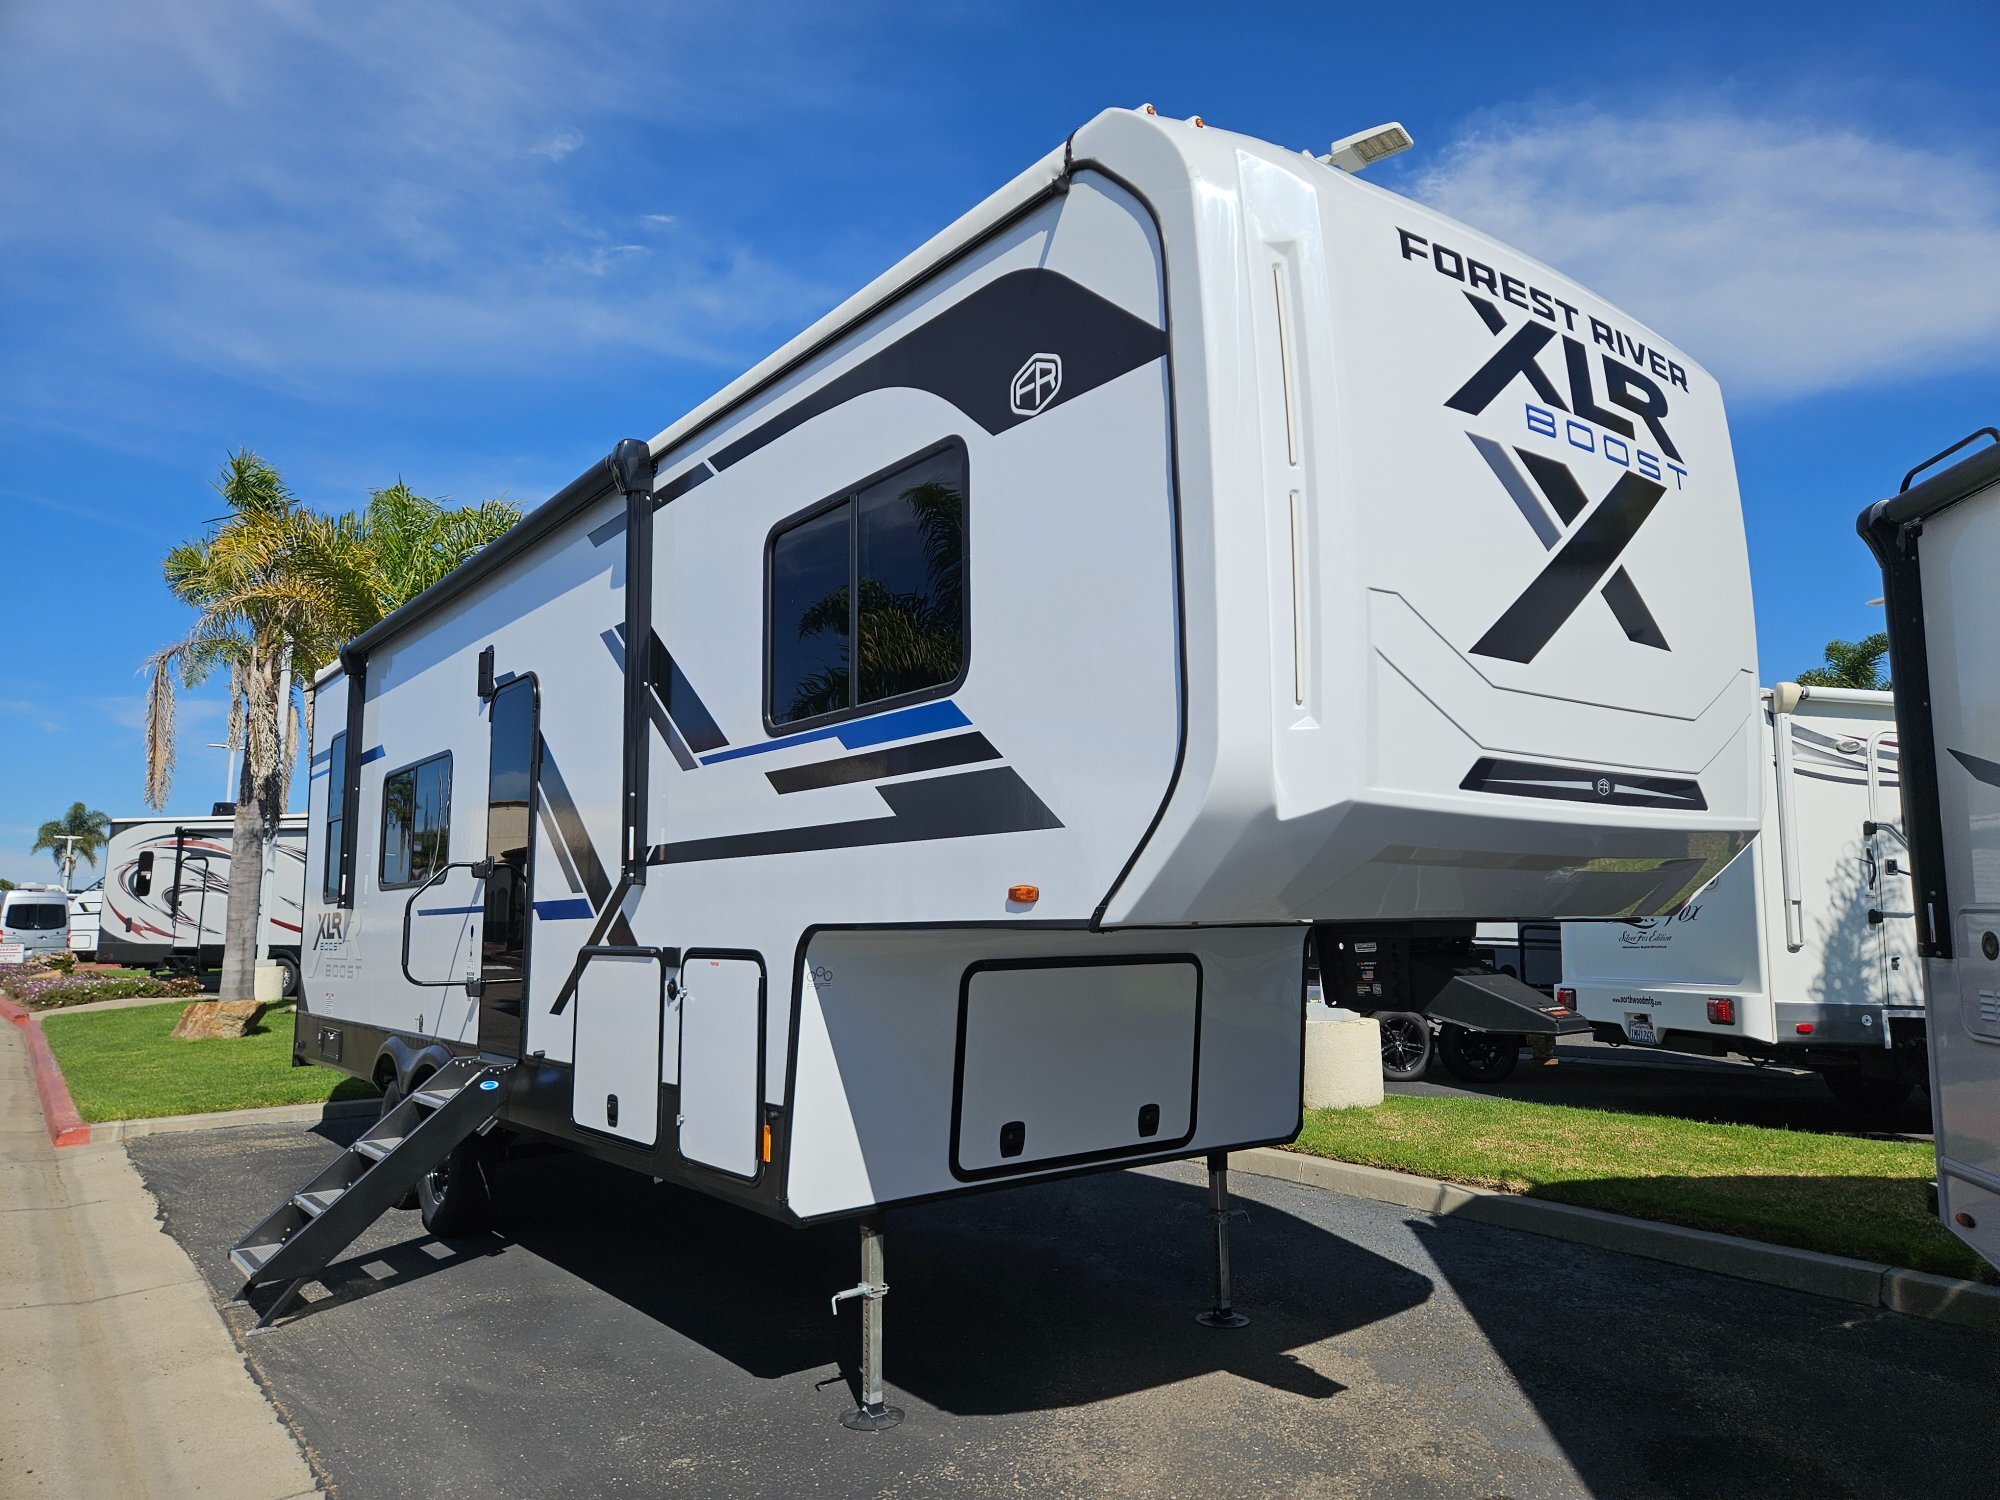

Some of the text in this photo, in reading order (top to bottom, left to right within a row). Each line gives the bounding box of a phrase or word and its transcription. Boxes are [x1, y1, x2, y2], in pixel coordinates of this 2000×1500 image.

[1395, 226, 1690, 393] FOREST RIVER
[1443, 289, 1685, 464] XLR
[1525, 403, 1688, 490] BOOST
[313, 911, 343, 950] XLR
[319, 942, 344, 951] BOOST
[325, 963, 363, 980] BOOST
